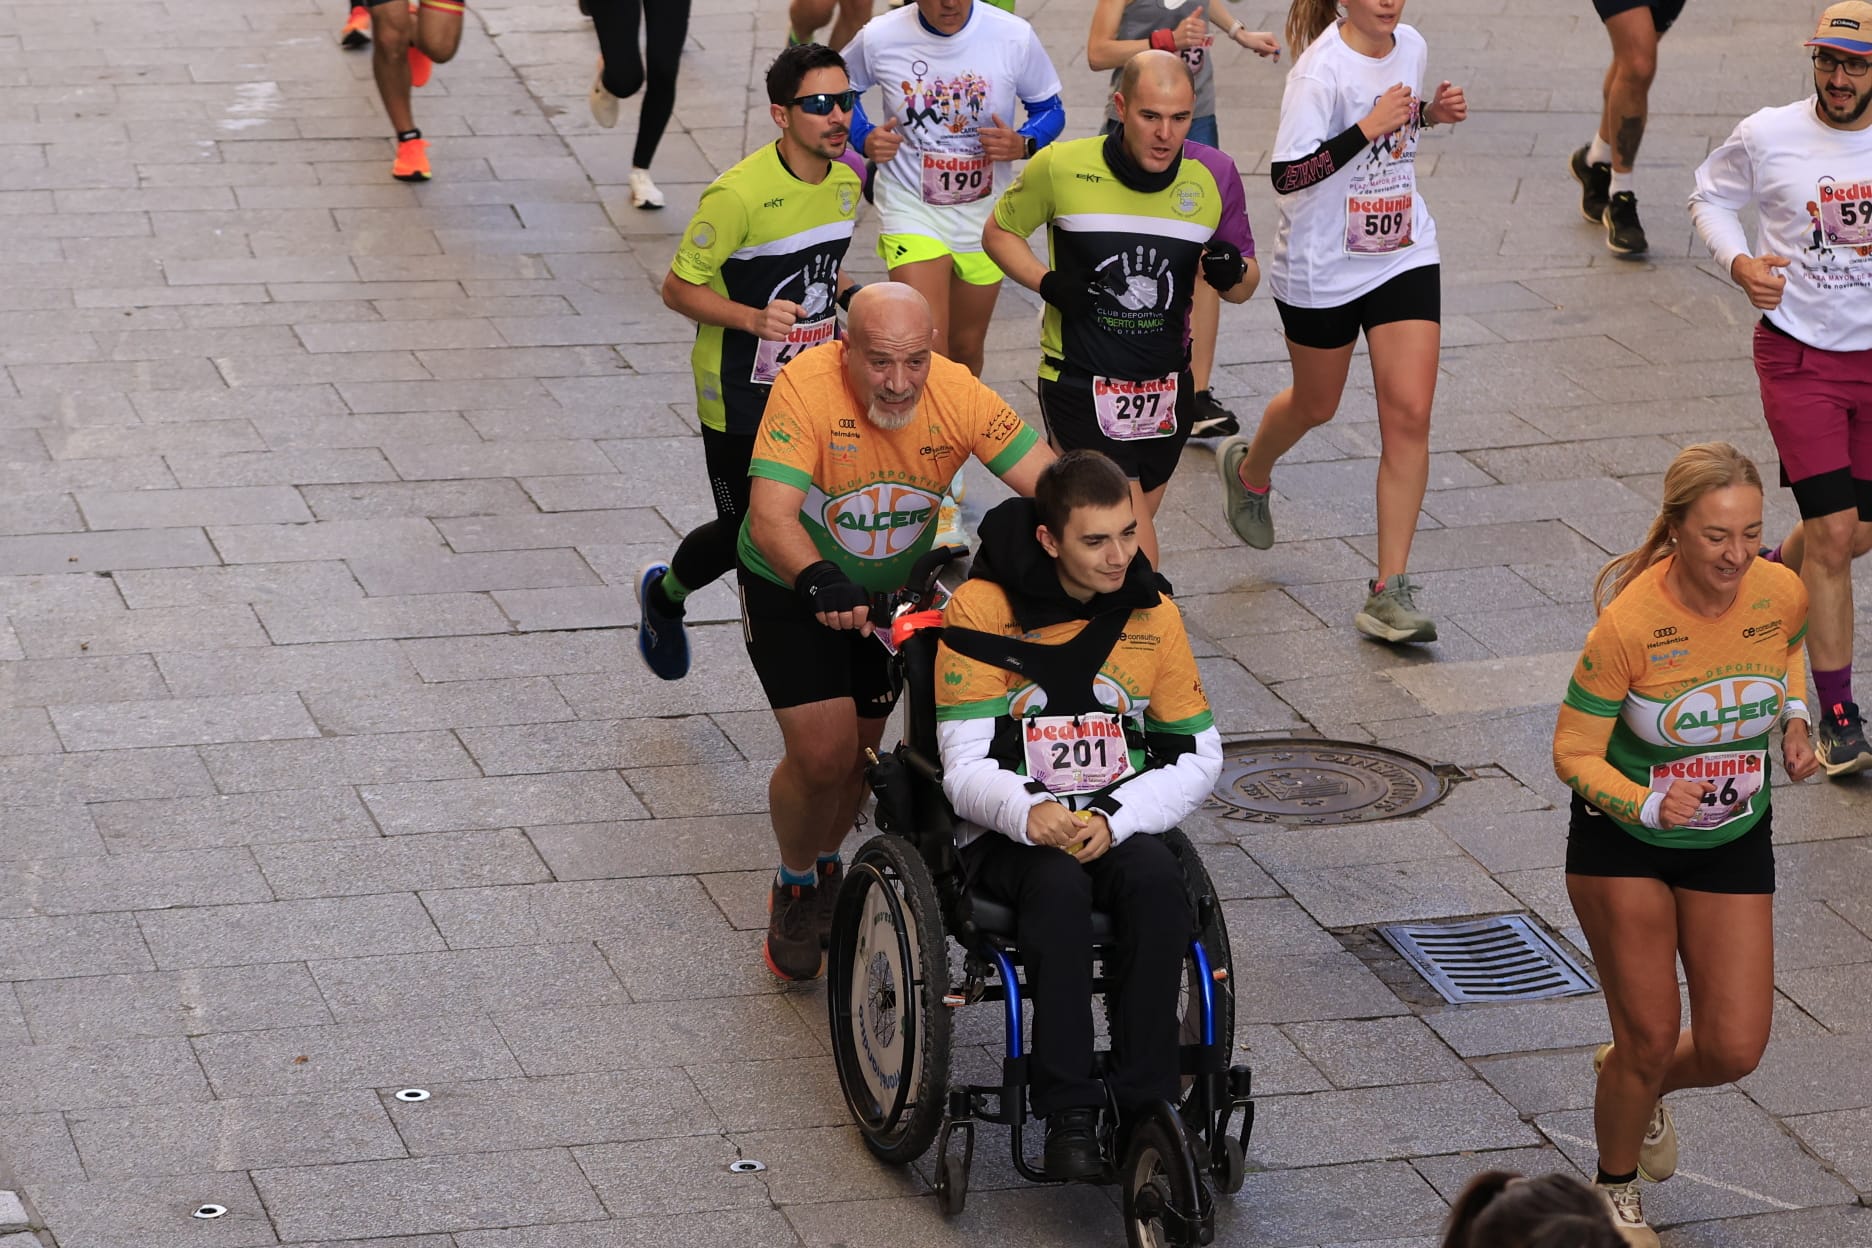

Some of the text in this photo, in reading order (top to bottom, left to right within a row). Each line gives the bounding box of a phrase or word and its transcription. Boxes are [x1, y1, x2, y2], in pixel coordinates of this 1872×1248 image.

[939, 171, 982, 191] 190
[1365, 212, 1403, 236] 509
[1097, 308, 1119, 317] CLUB
[788, 323, 833, 342] dunia
[1095, 379, 1175, 395] bedunia
[1116, 393, 1160, 420] 297
[834, 506, 932, 531] ALCER
[1673, 694, 1780, 731] ALCER
[1026, 718, 1123, 742] bedunia
[1051, 738, 1107, 770] 201
[1653, 754, 1761, 778] bedunia
[1700, 778, 1738, 807] 46
